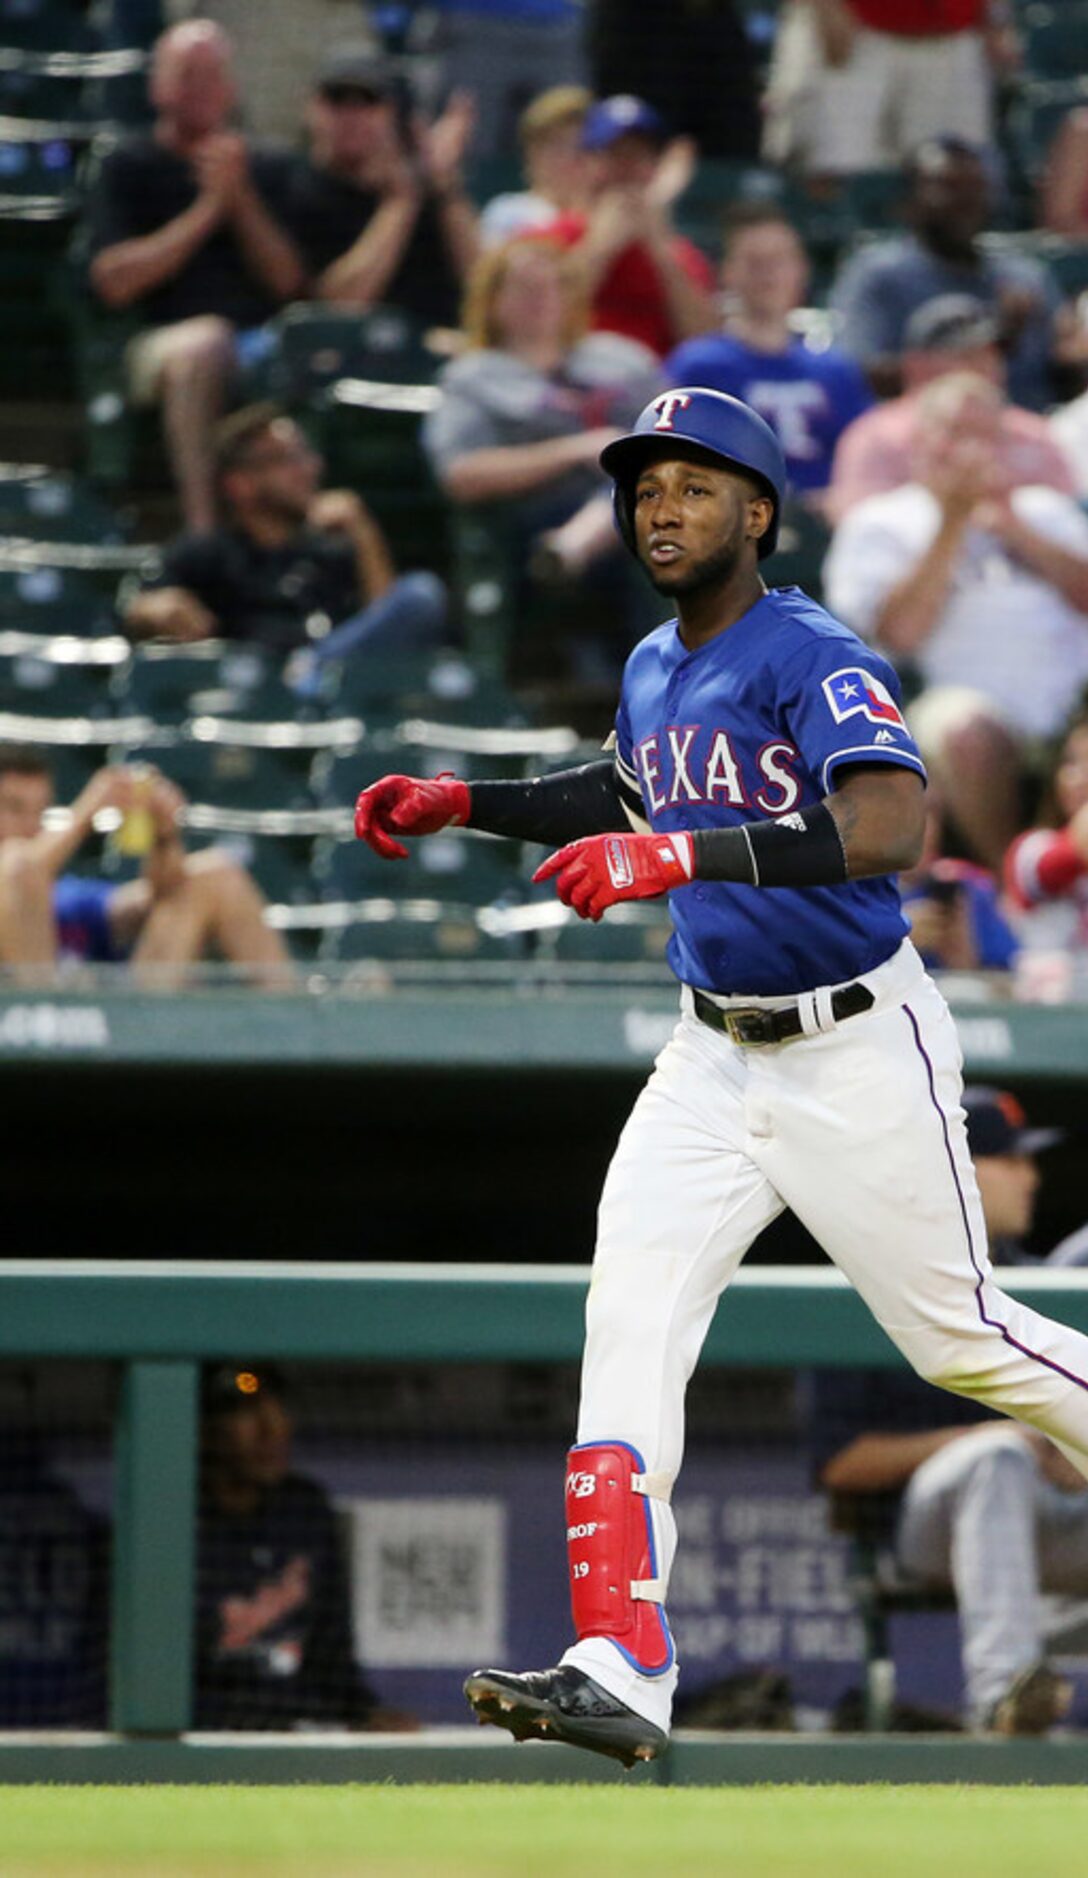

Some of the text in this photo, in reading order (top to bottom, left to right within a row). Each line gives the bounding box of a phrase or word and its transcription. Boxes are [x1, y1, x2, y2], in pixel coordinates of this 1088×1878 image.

[653, 394, 691, 431] T
[748, 382, 827, 460] T
[634, 725, 802, 816] EXAS
[573, 1560, 590, 1580] 19
